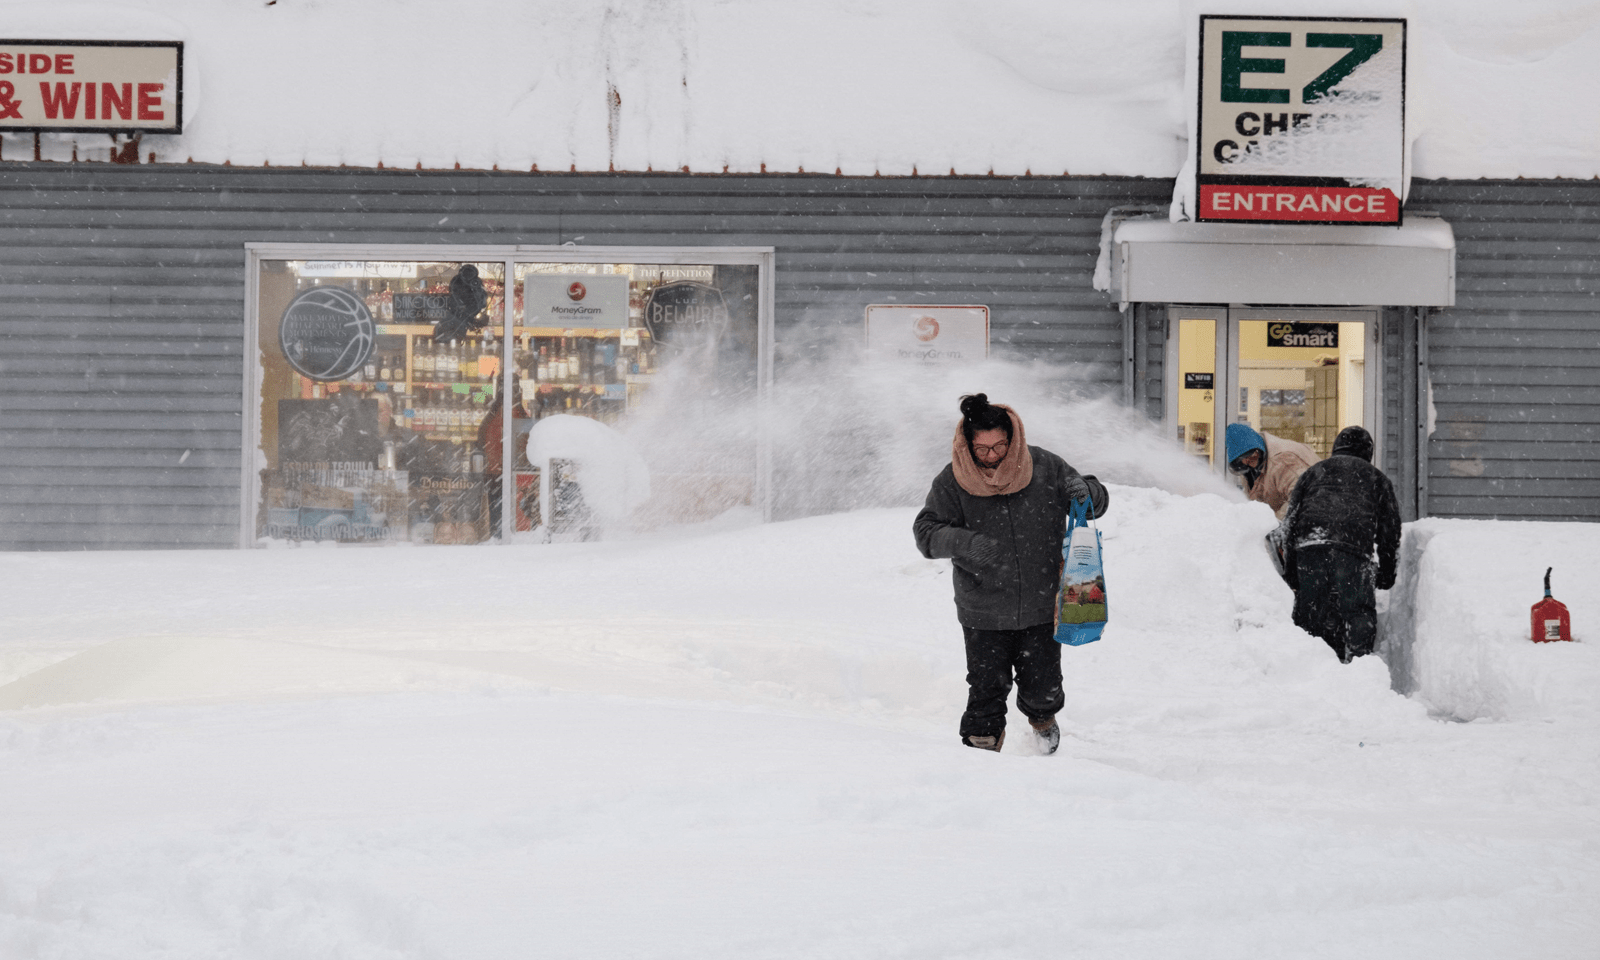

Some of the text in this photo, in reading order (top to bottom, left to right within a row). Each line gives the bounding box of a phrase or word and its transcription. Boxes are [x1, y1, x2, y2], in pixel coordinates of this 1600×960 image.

[0, 53, 75, 74] SIDE
[1220, 31, 1383, 104] EZ
[39, 82, 164, 120] WINE
[1212, 192, 1386, 213] ENTRANCE
[641, 269, 657, 278] THE
[660, 269, 712, 278] DEFINITION
[395, 295, 450, 309] BAREFOOT
[396, 309, 416, 319] WINE
[551, 306, 602, 316] MoneyGram
[653, 303, 722, 323] BELAIRE
[1270, 323, 1293, 340] Go
[1283, 329, 1335, 346] smart
[332, 461, 373, 471] TEQUILA
